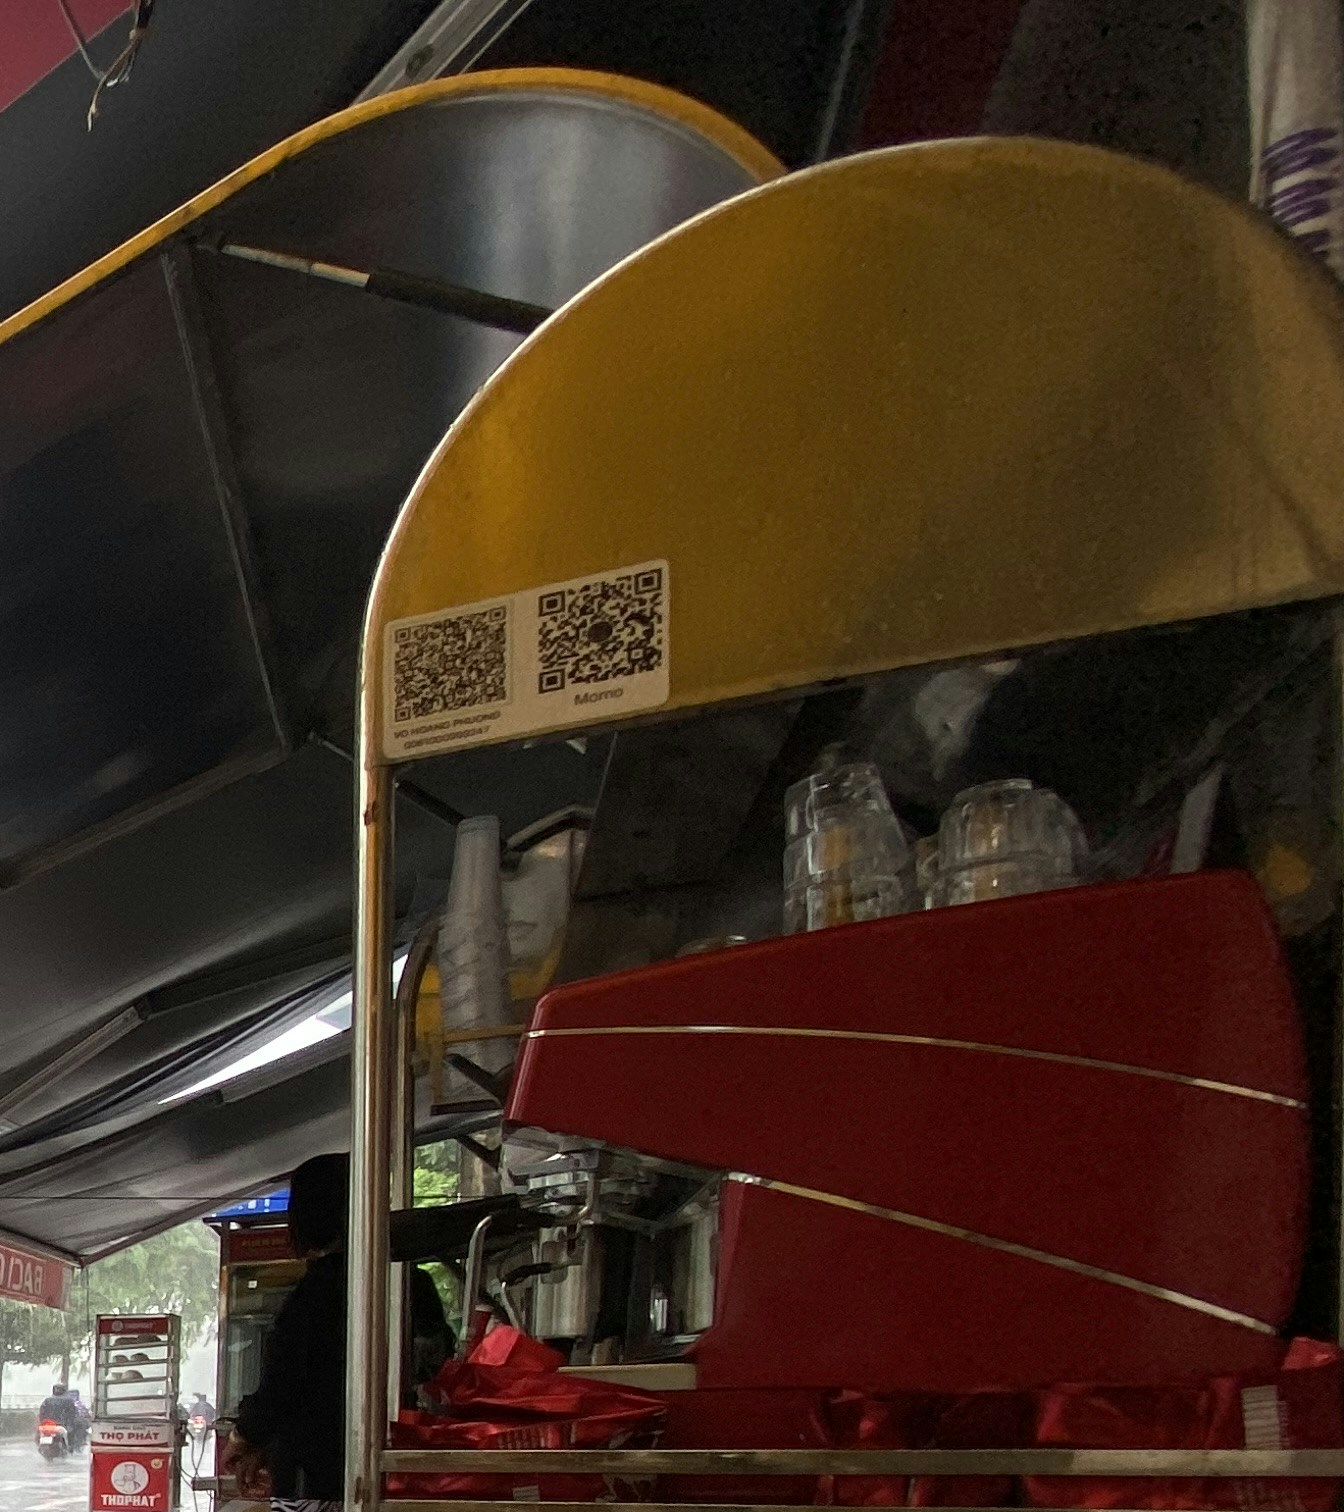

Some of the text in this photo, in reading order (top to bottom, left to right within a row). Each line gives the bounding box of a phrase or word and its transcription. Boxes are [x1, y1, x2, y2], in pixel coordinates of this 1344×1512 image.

[573, 687, 624, 706] Momo
[100, 1430, 160, 1442] THỌ PHÁT
